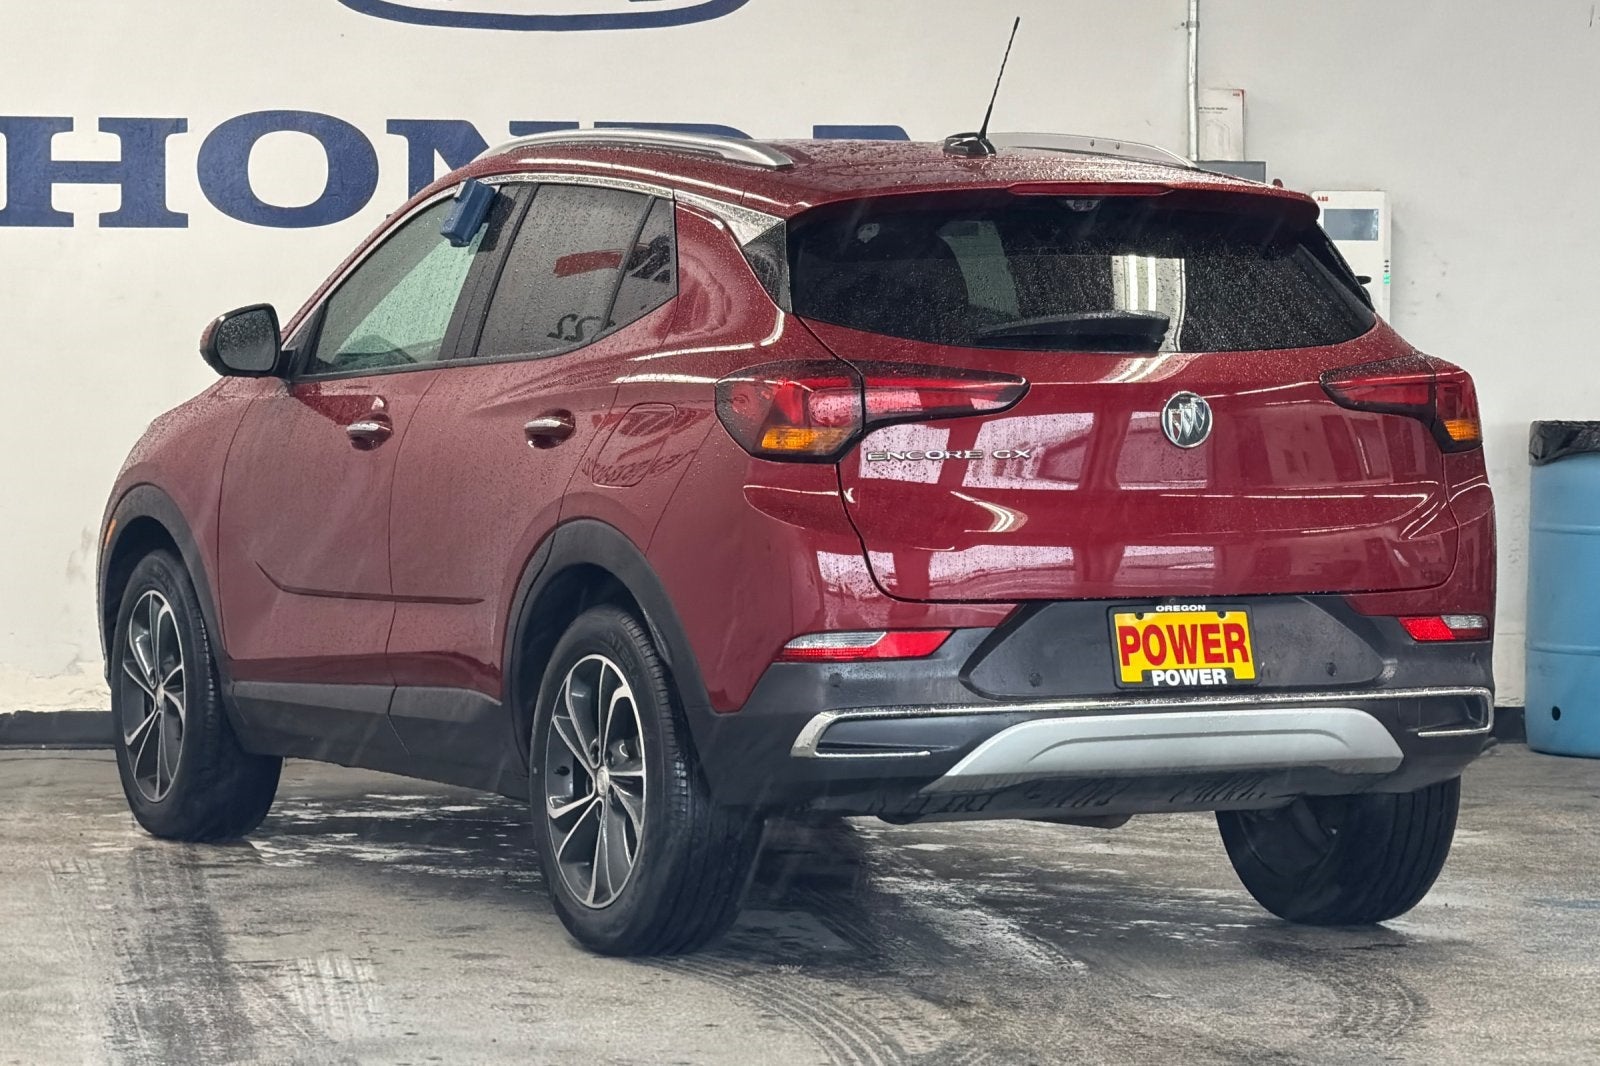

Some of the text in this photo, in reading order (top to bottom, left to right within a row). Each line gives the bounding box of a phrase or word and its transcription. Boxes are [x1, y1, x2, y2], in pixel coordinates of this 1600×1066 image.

[866, 449, 1031, 461] ENCORE GX
[1155, 604, 1207, 612] OREGON
[1117, 622, 1250, 667] POWER
[1151, 668, 1228, 687] POWER
